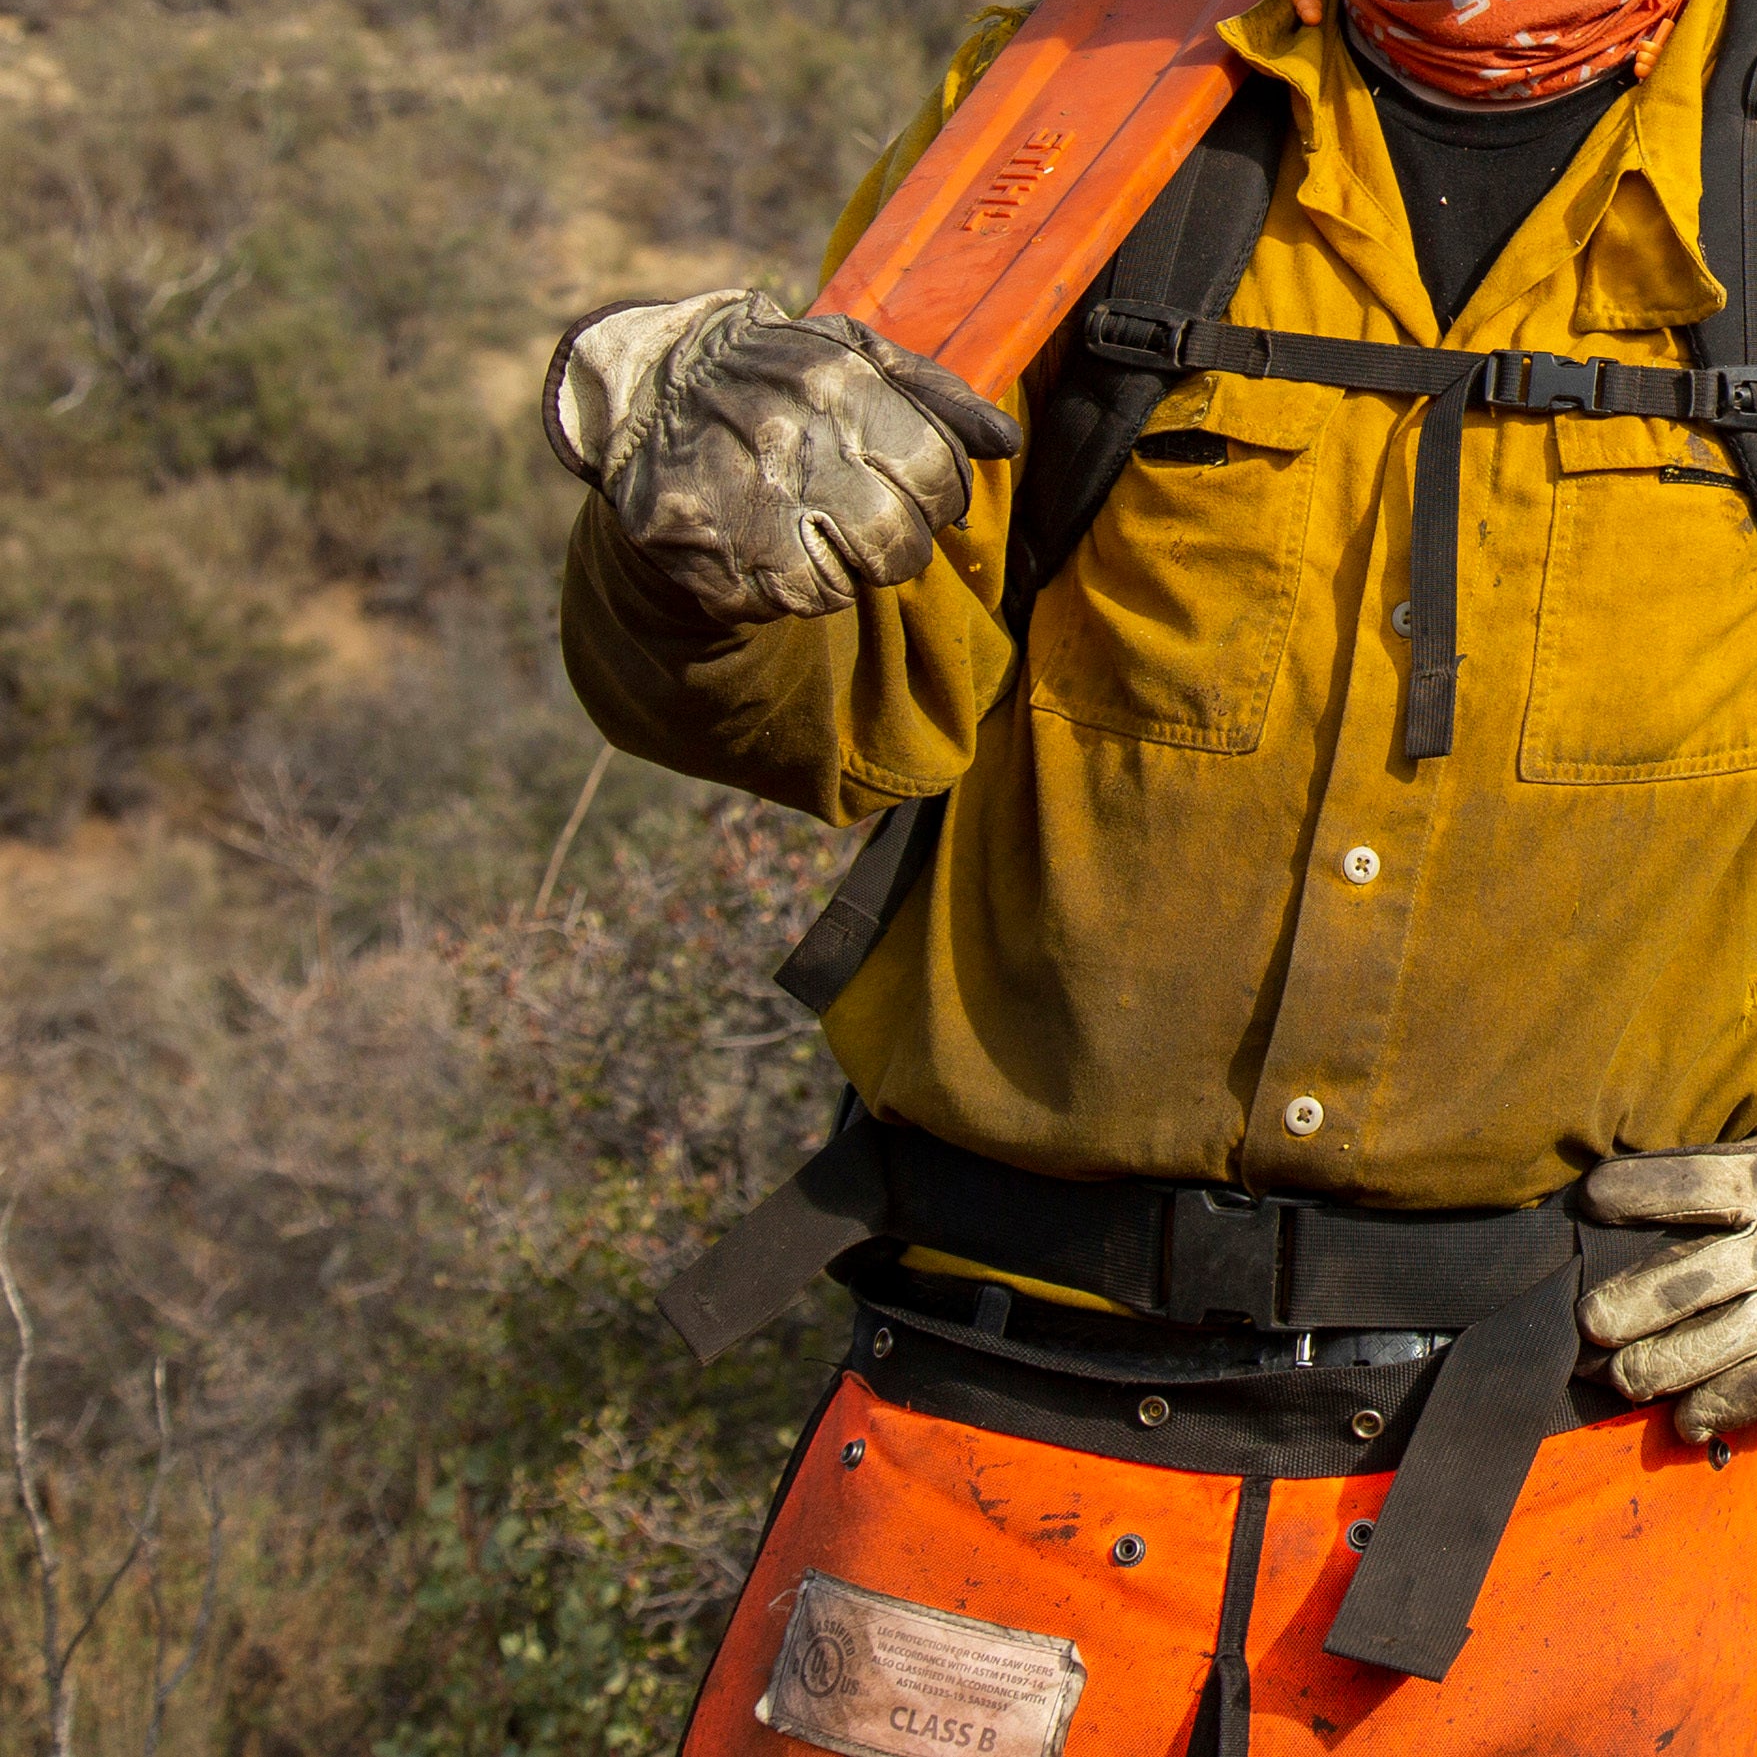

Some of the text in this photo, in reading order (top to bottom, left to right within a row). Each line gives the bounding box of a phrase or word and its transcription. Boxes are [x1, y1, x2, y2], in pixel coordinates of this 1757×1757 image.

[877, 1626, 1055, 1677] LEG PROTECTION FOR CHAIN SAW USERS
[877, 1641, 888, 1651] IN
[888, 1644, 947, 1668] ACCORDANCE
[948, 1661, 971, 1673] WITH
[972, 1667, 999, 1679] ASTM
[840, 1675, 860, 1696] US
[871, 1655, 1047, 1705] ALSO CLASSIFIED IN ACCORDANCE WITH
[896, 1677, 922, 1691] ASTM
[889, 1706, 997, 1752] CLASS B
